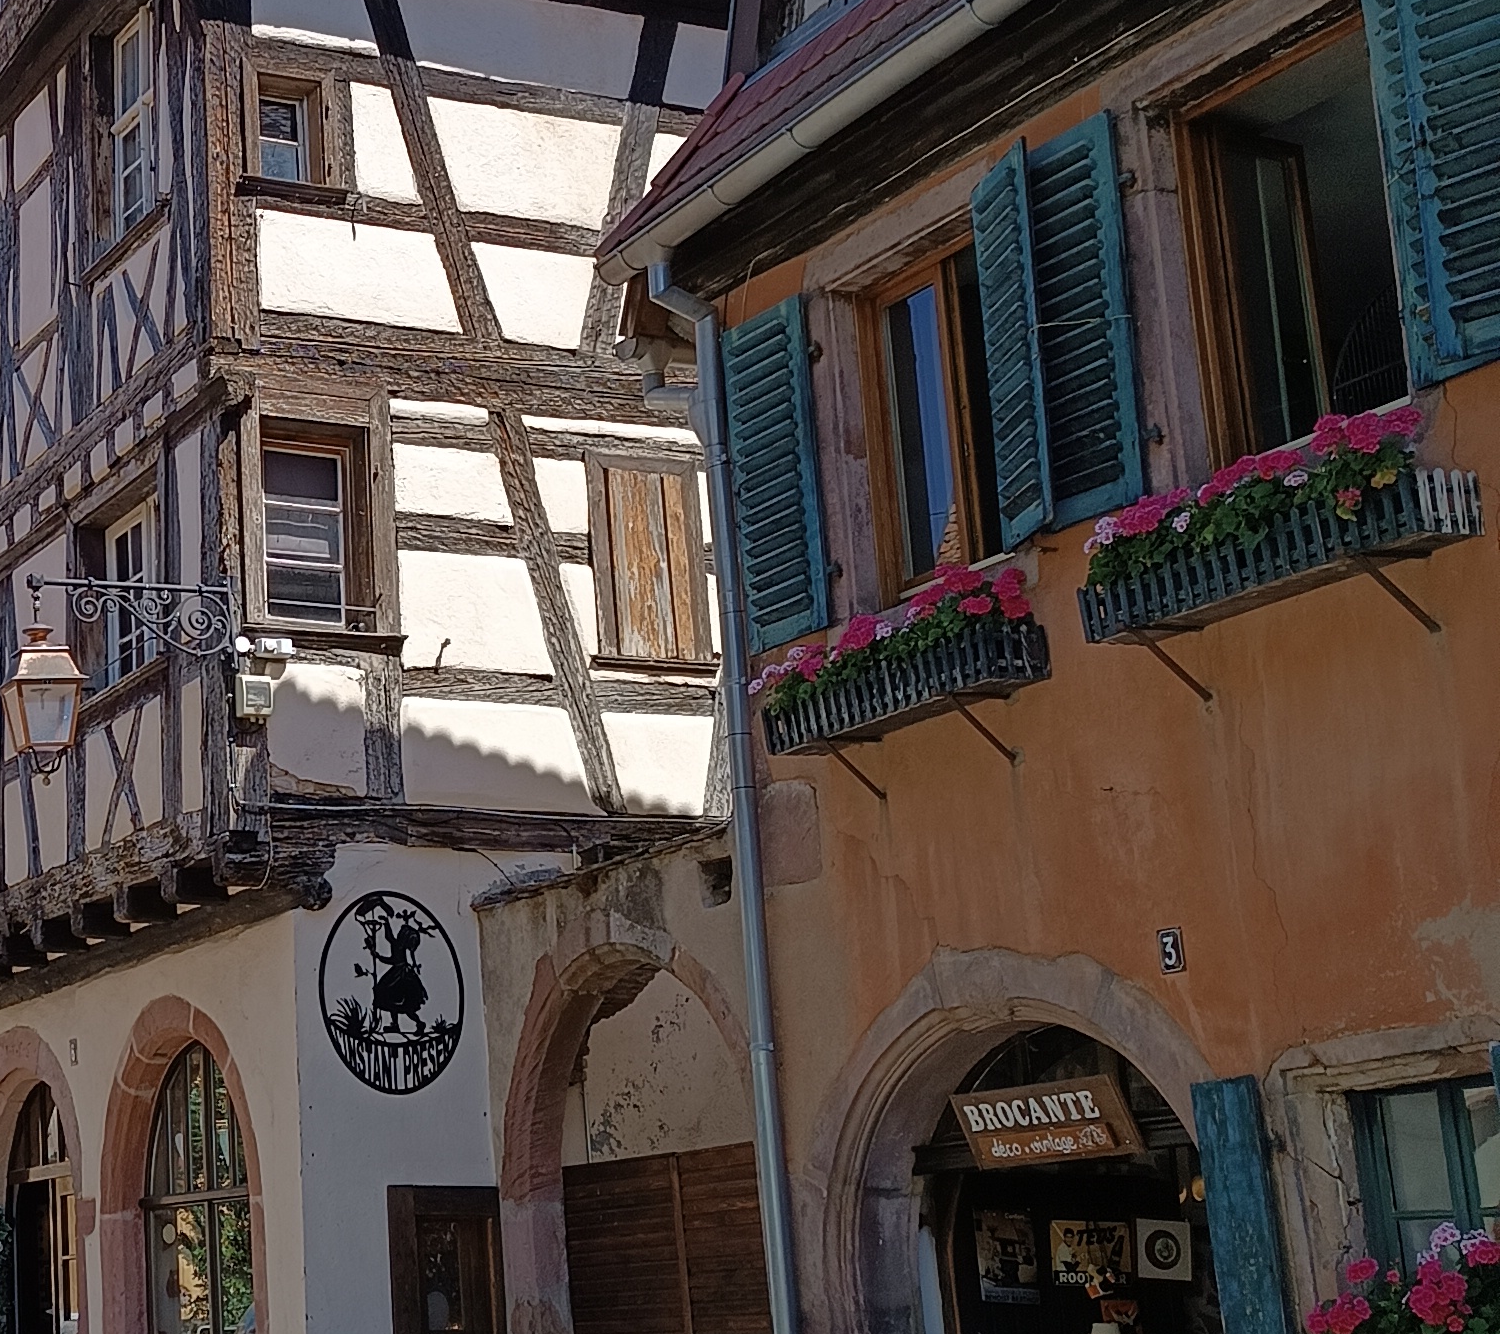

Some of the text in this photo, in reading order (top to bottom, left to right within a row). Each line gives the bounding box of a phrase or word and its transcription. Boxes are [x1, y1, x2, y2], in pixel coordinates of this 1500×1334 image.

[1162, 935, 1177, 966] 3
[963, 1090, 1100, 1132] BROCANTE
[991, 1132, 1078, 1158] déco vintage
